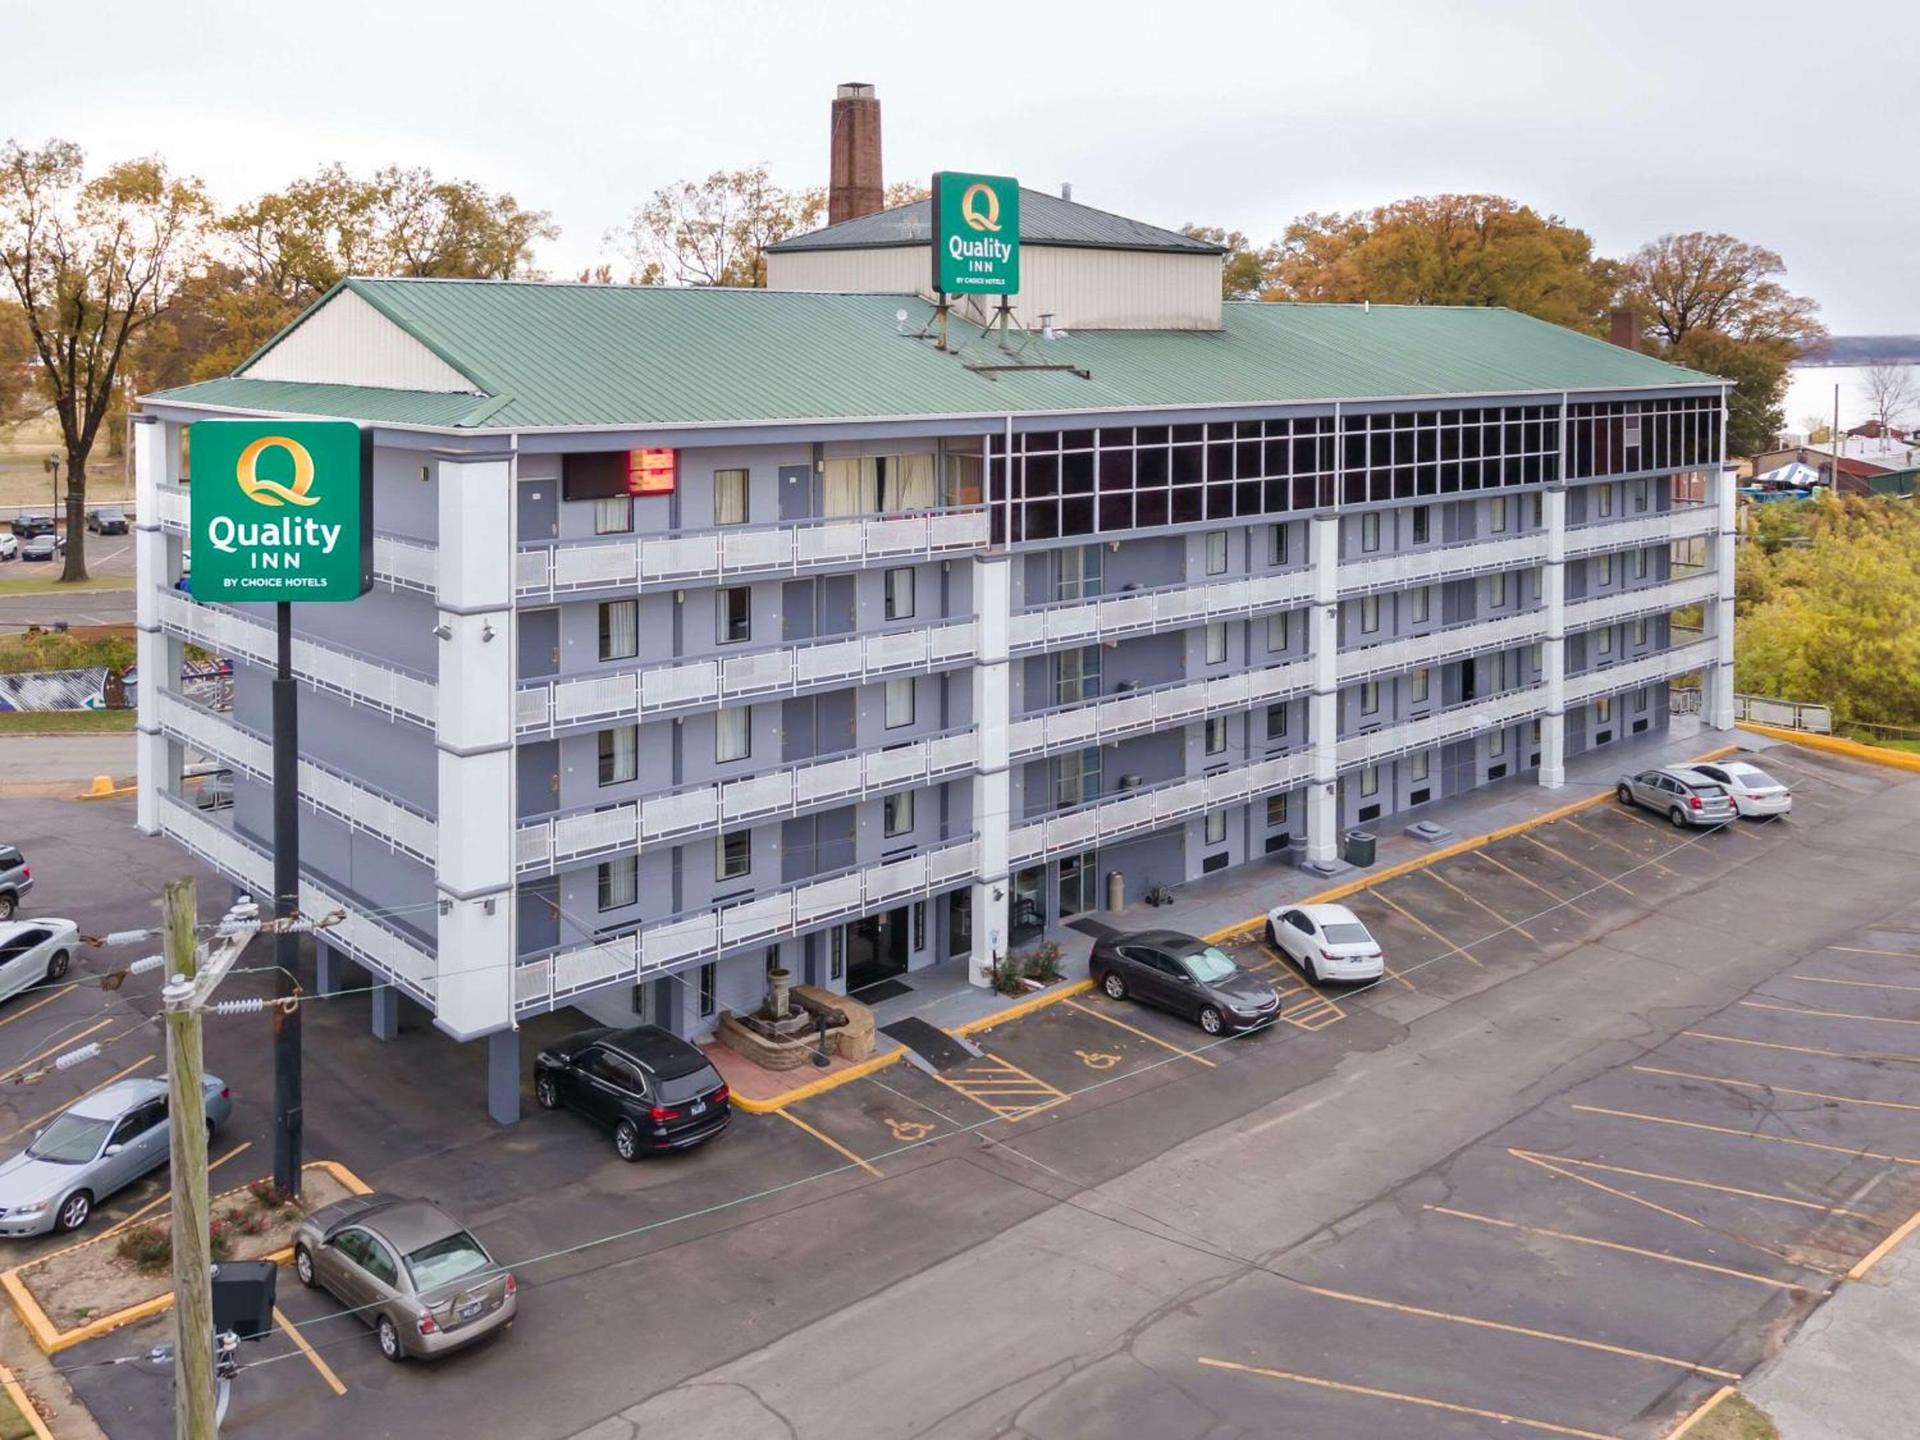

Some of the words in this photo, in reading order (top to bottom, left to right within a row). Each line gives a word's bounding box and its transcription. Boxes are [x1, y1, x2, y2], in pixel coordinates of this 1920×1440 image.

[962, 183, 1002, 231] Q
[949, 235, 1012, 264] Quality
[969, 261, 993, 273] INN
[236, 435, 321, 507] Q
[208, 515, 342, 554] Quality
[251, 552, 300, 569] INN
[223, 578, 237, 588] BY
[240, 578, 283, 588] CHOICE
[285, 578, 328, 588] HOTELS
